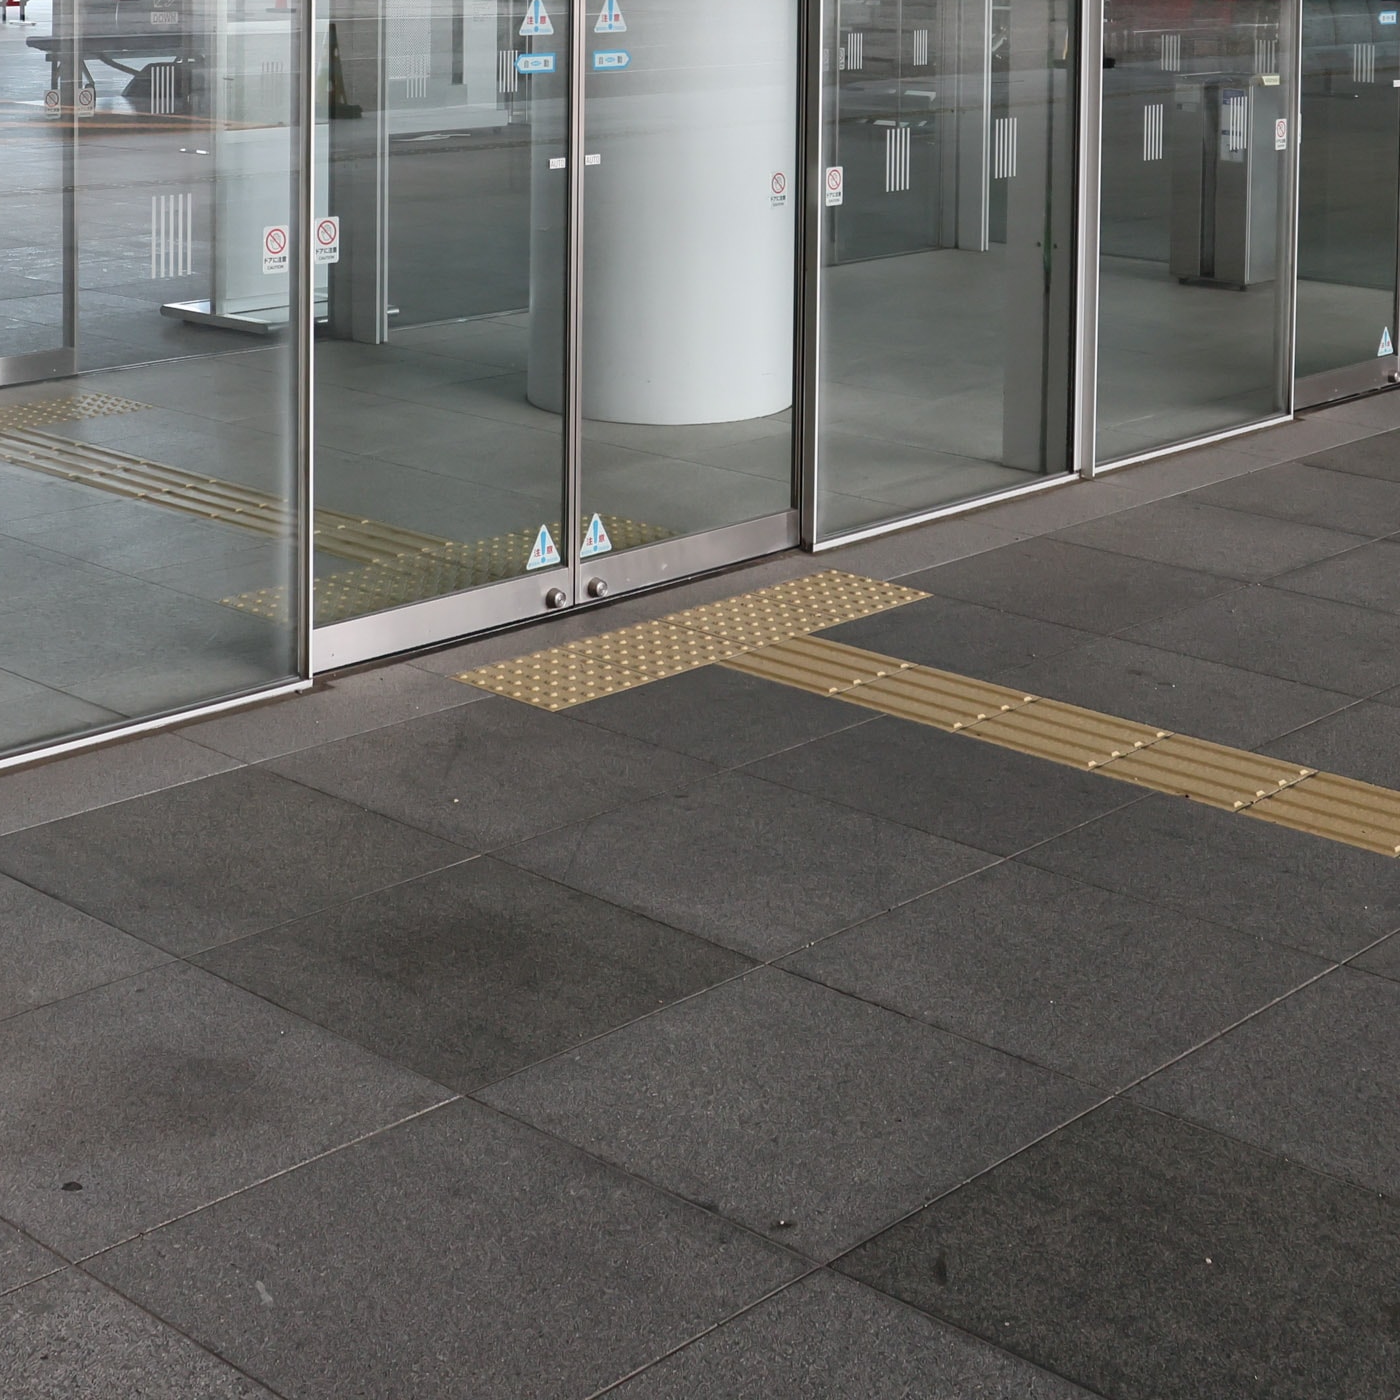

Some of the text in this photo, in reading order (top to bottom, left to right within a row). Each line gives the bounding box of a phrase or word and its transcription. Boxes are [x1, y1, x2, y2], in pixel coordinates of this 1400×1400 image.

[315, 246, 337, 255] ドアに注意
[264, 255, 287, 264] ドアに注意
